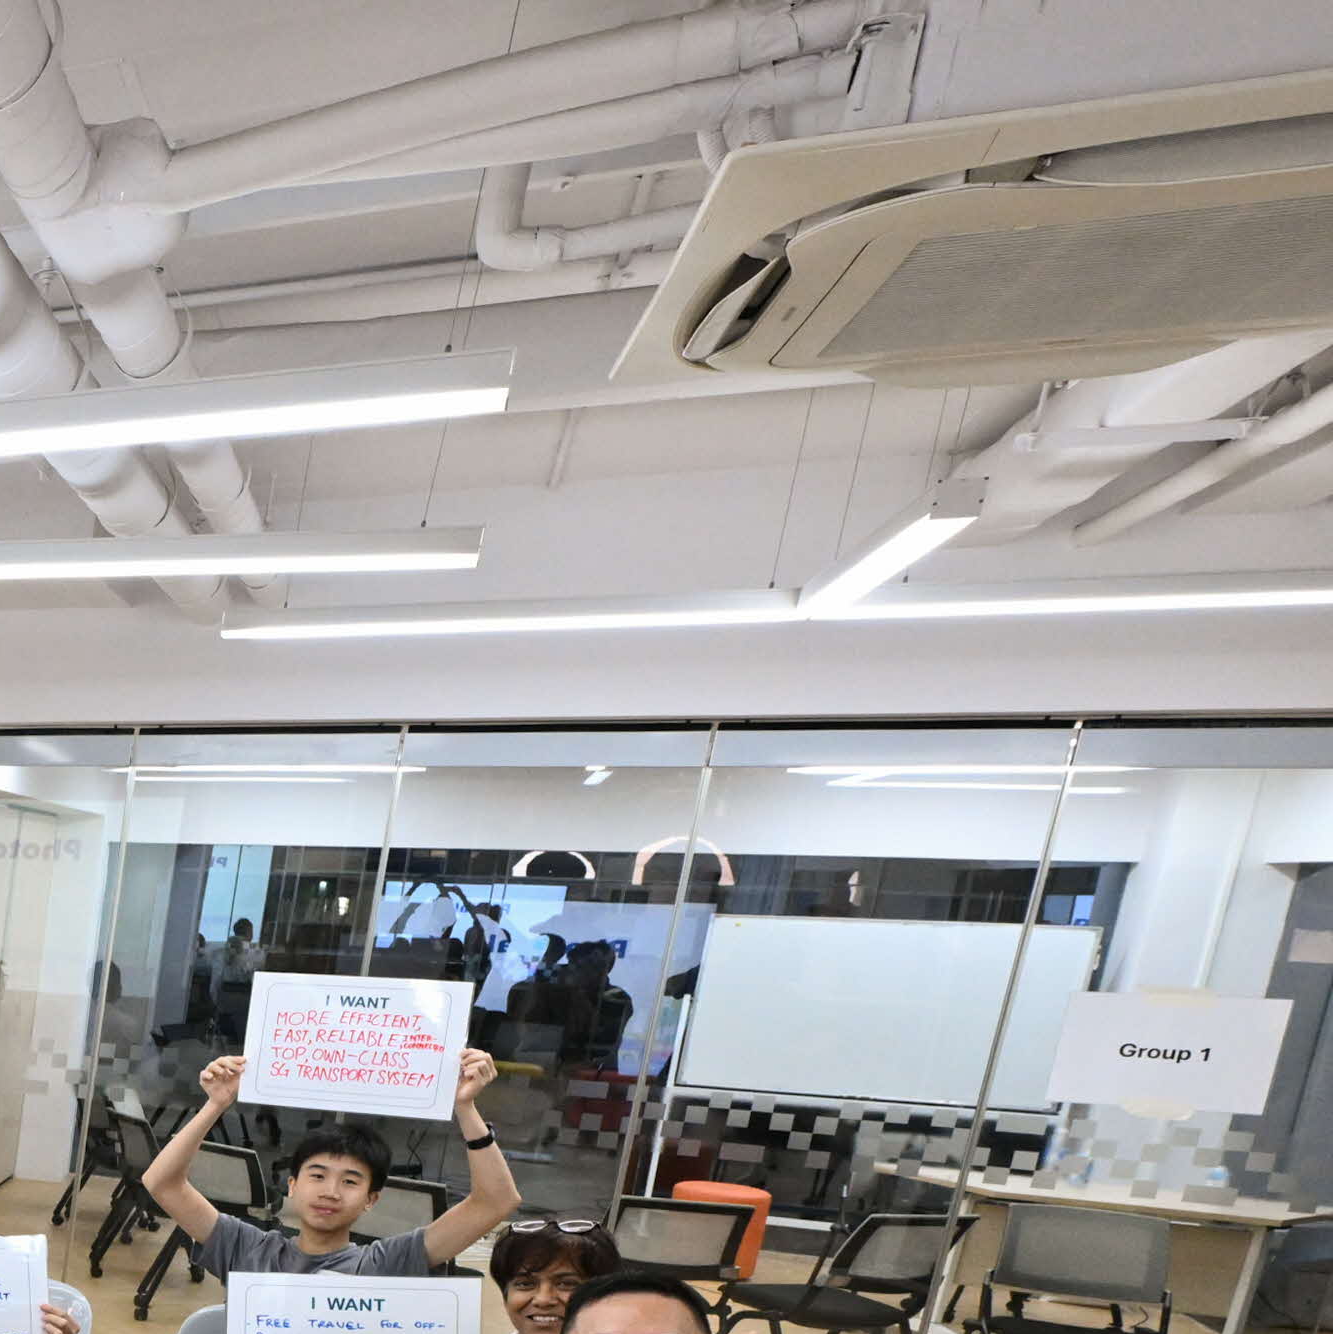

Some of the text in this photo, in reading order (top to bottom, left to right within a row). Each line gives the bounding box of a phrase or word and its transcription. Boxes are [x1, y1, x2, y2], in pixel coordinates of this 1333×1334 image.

[326, 995, 390, 1008] I WANT
[276, 1011, 422, 1031] MORE EFFICIENT,
[273, 1029, 313, 1045] FAST,
[271, 1046, 410, 1069] TOP, OWN-CLASS
[1119, 1043, 1211, 1064] Group 1
[270, 1061, 435, 1089] SG TRANSPORT SYSTEM
[311, 1297, 386, 1313] I WANT
[256, 1314, 292, 1329] FREE
[308, 1319, 365, 1331] TRAVEL
[381, 1319, 403, 1330] FOR
